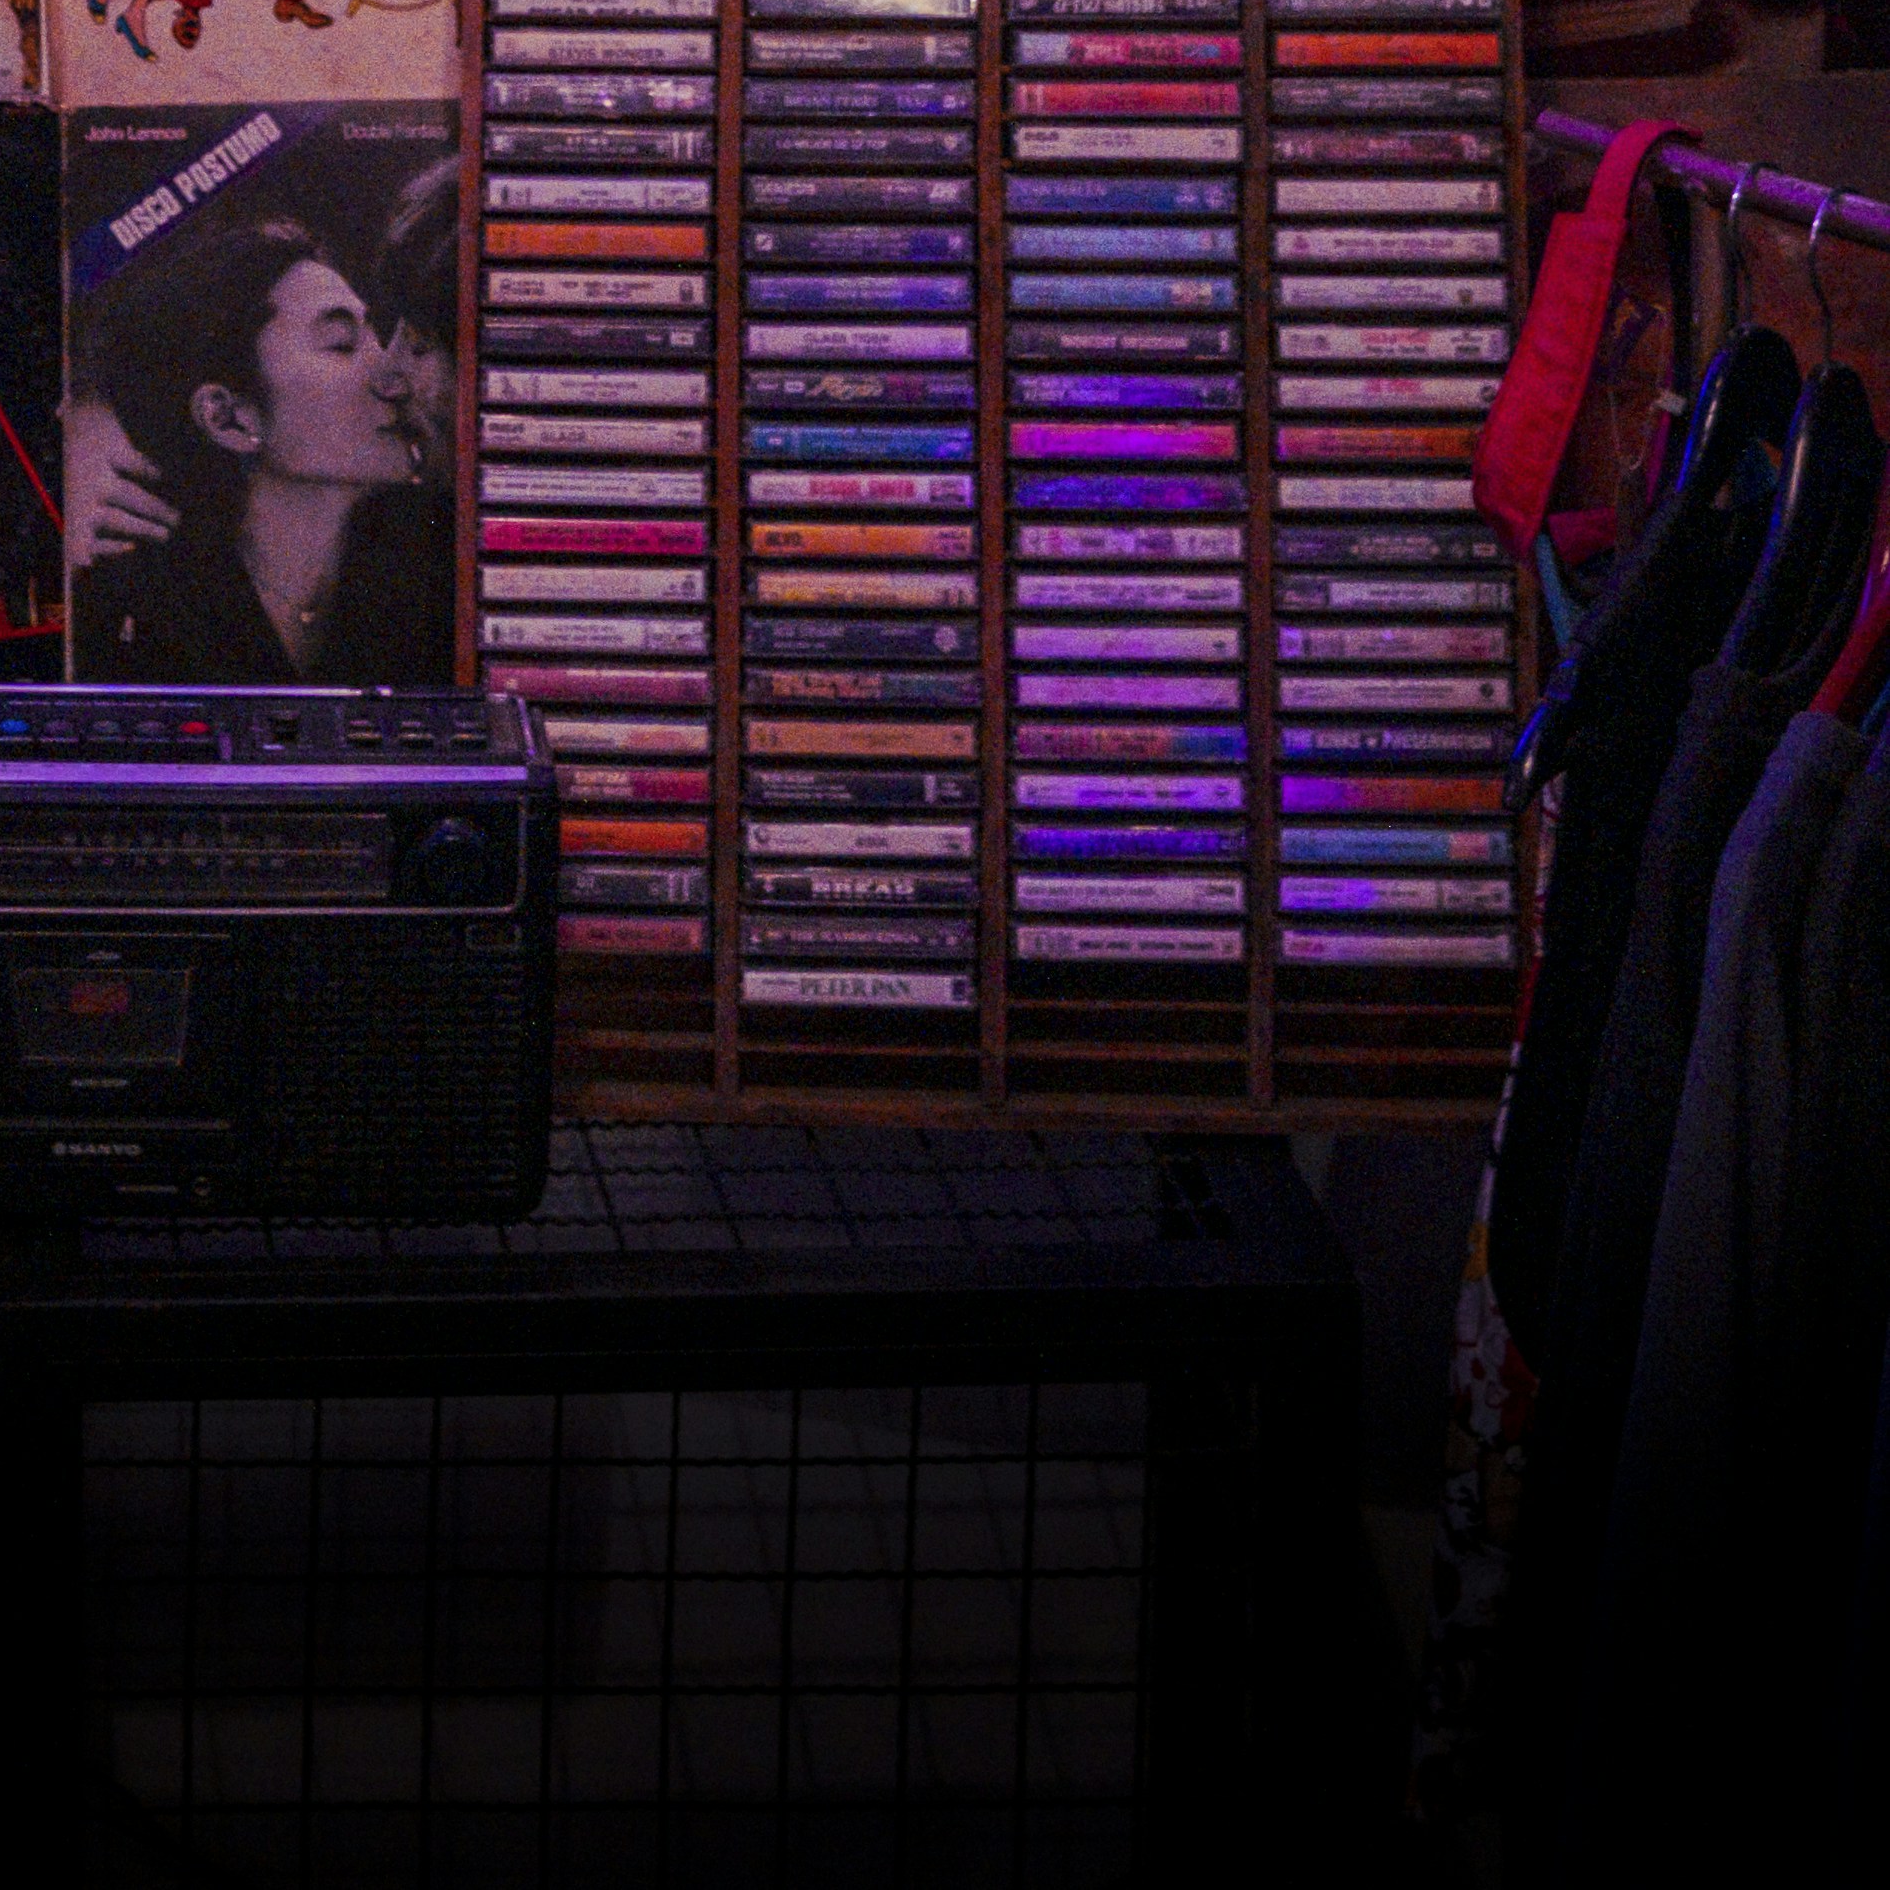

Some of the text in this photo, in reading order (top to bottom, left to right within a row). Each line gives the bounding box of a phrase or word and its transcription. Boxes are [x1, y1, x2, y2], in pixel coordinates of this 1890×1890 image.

[85, 126, 124, 142] John
[127, 126, 188, 142] Lennon
[109, 110, 284, 251] DISCO POSTUMO
[799, 976, 911, 997] PETER PAN
